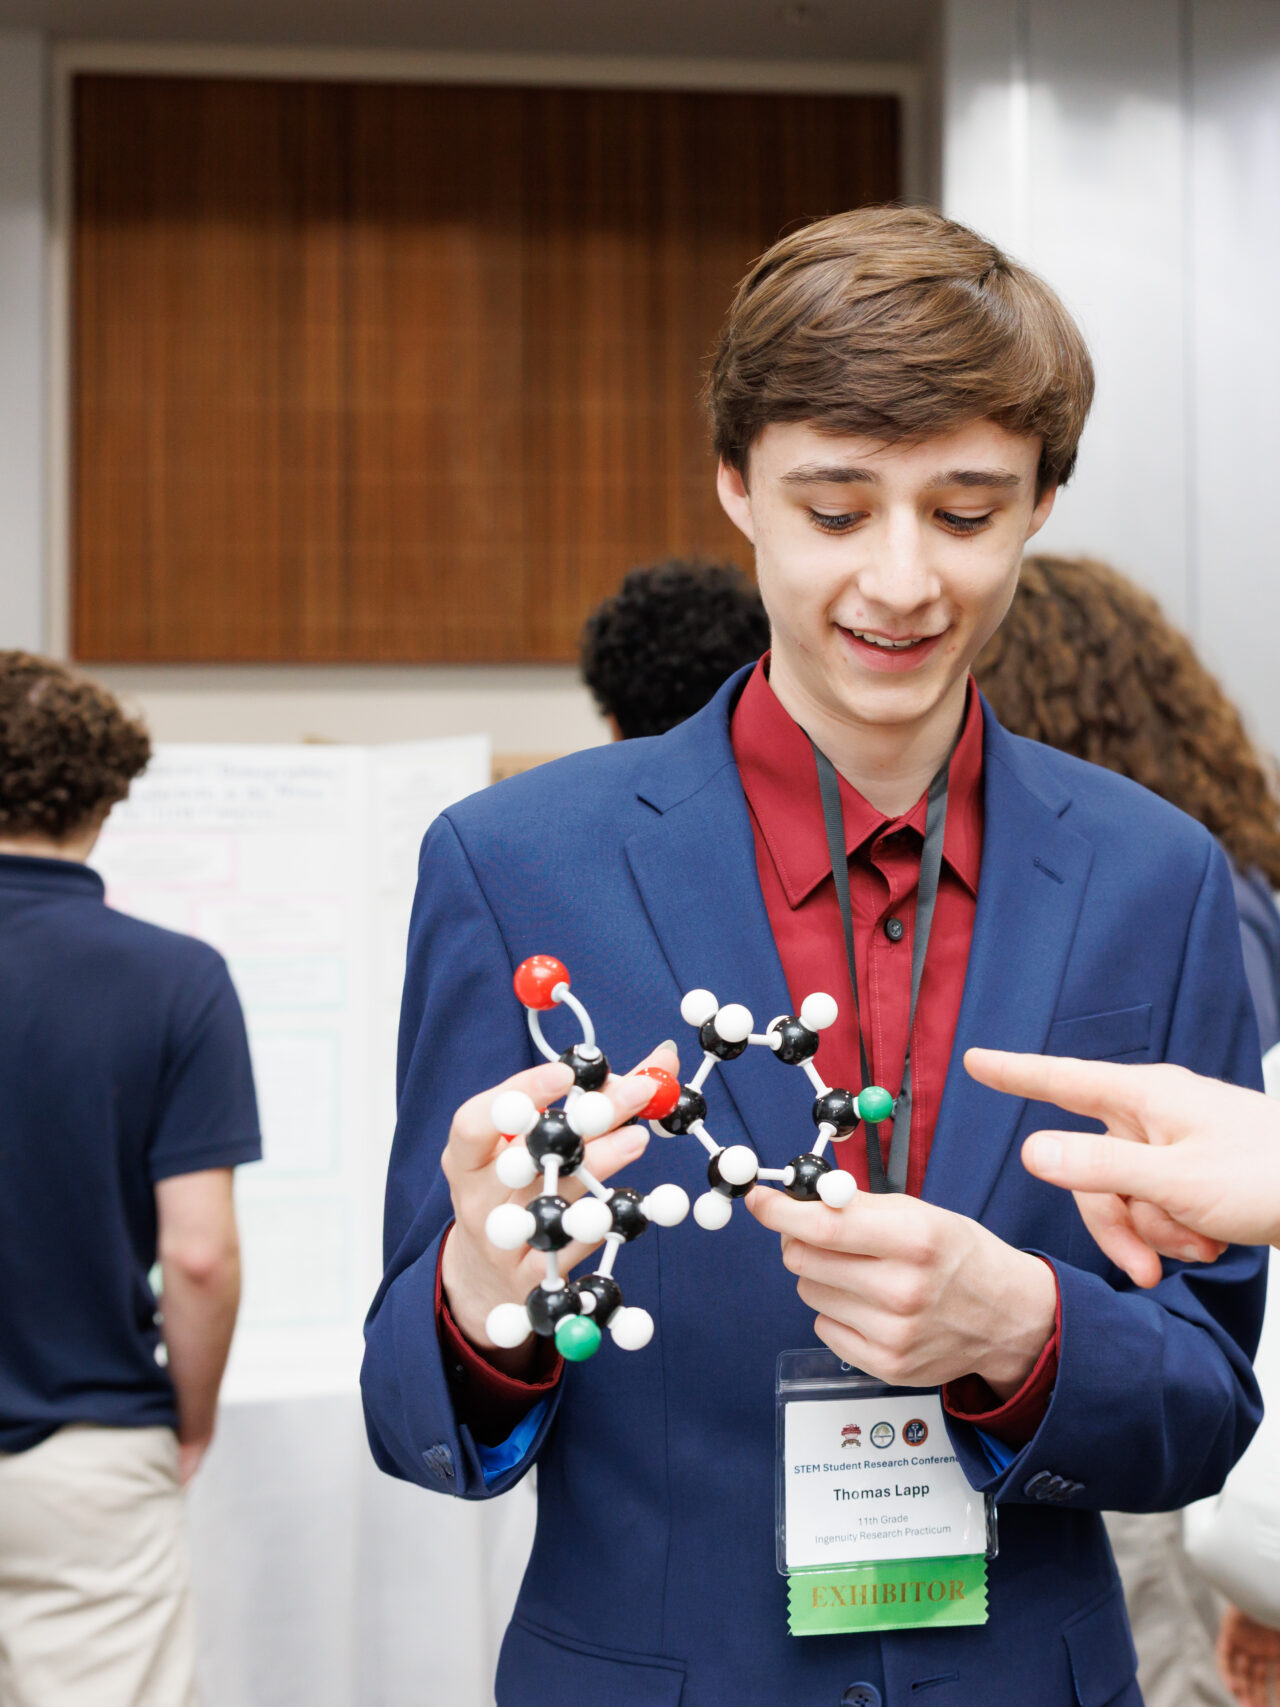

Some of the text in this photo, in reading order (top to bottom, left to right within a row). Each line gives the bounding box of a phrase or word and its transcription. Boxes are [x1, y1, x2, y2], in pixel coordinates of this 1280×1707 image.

[794, 1455, 960, 1474] STEM Student Research Conferen
[833, 1483, 930, 1501] Thomas Lapp
[858, 1514, 909, 1526] 11th Grade
[815, 1525, 952, 1545] Ingenuity Research Practicum
[812, 1579, 966, 1608] EXHIBITOR
